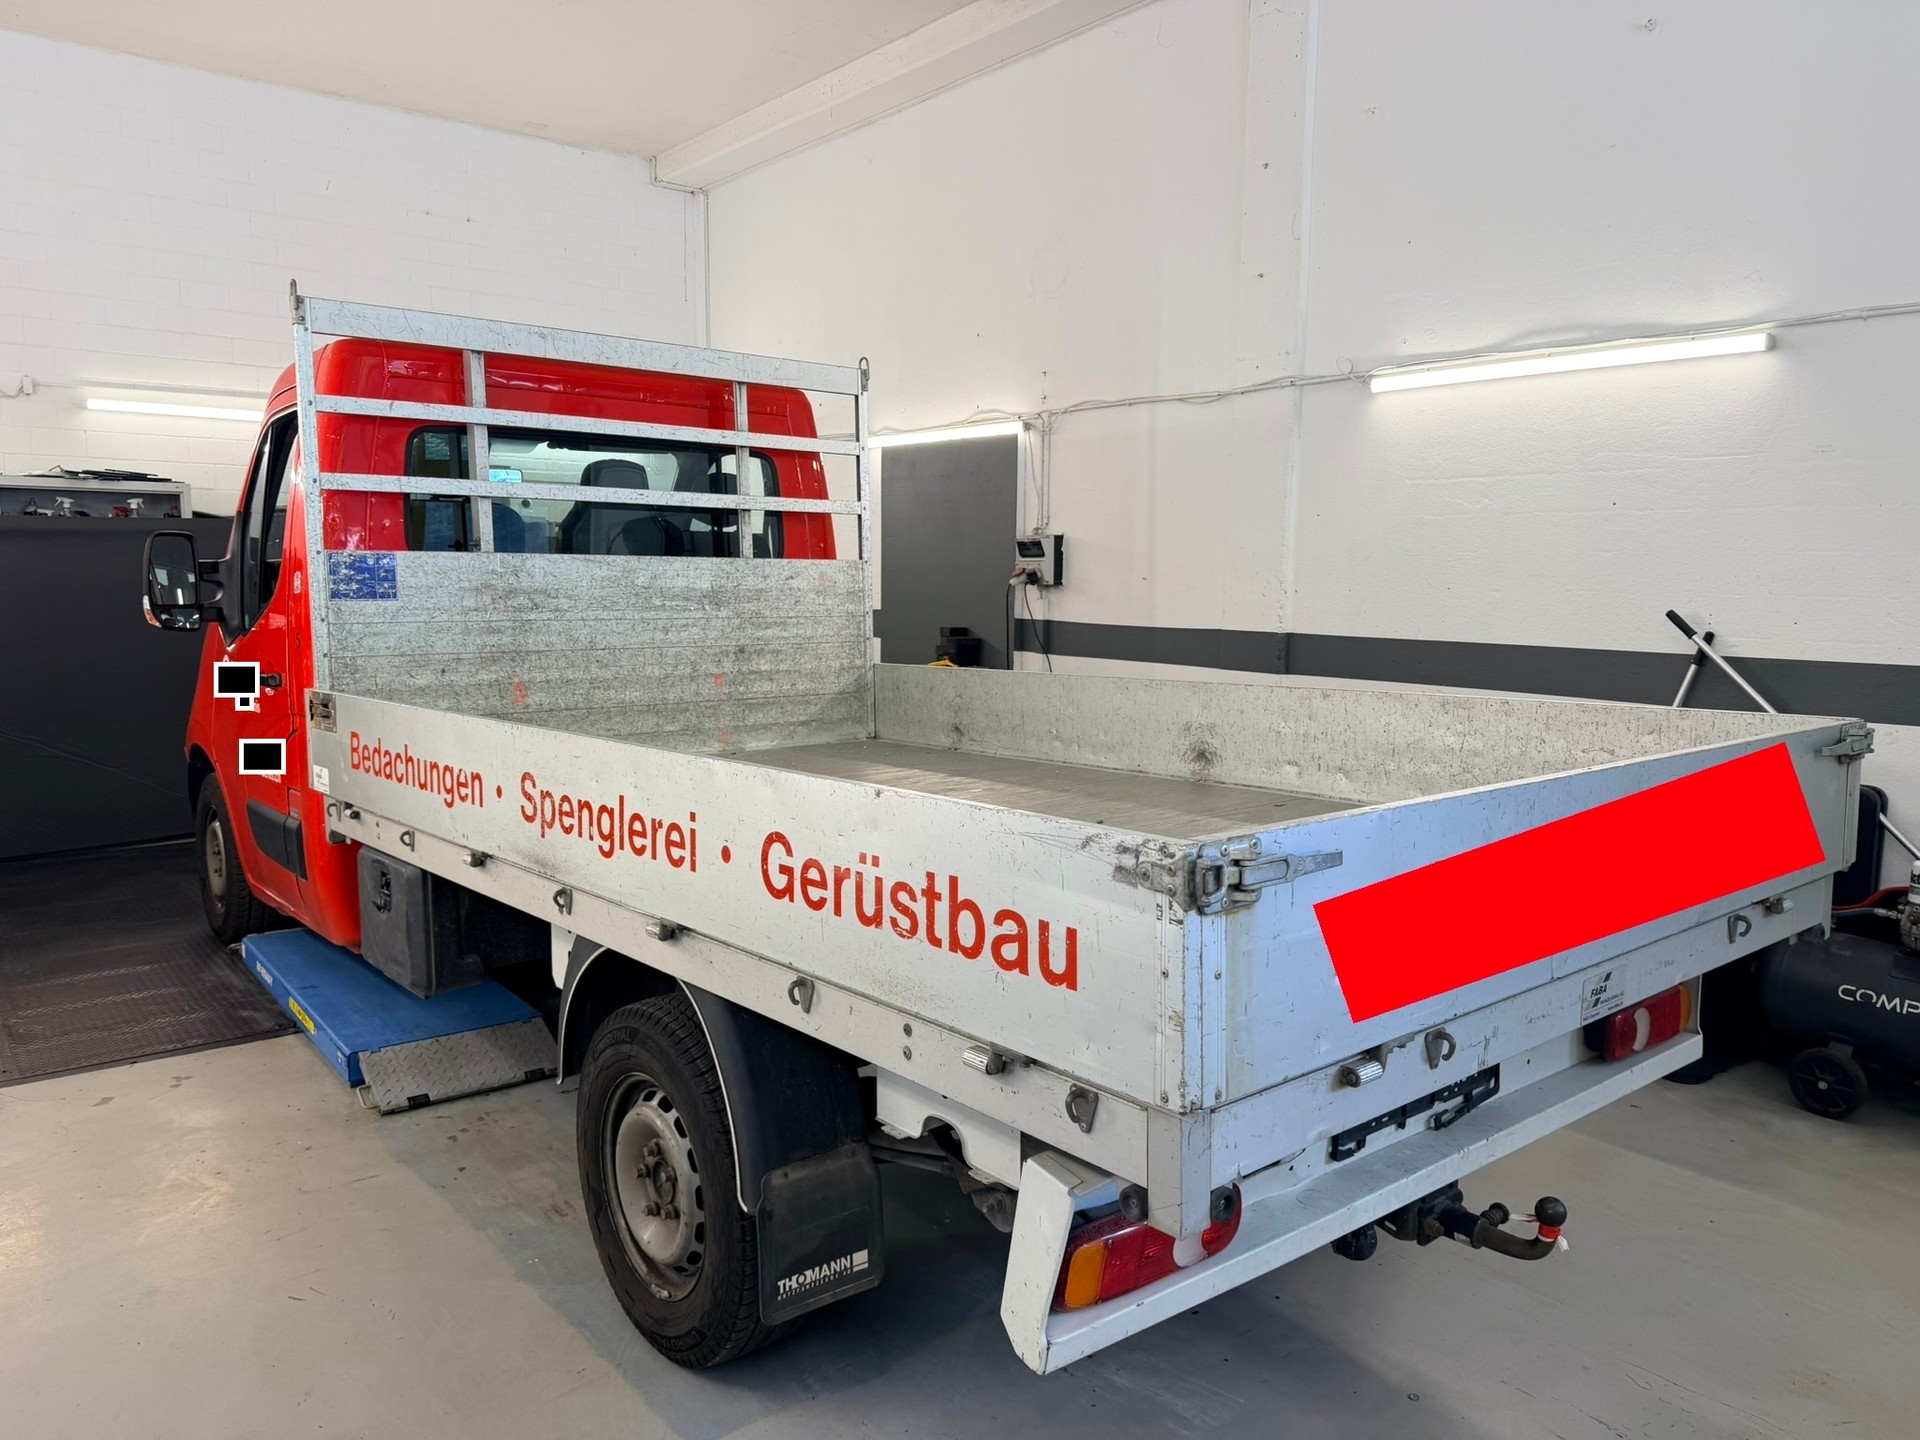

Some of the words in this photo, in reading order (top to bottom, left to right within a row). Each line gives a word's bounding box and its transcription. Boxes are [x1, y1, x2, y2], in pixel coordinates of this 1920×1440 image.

[350, 730, 485, 810] Bedachungen
[520, 772, 698, 873] Spenglerei
[760, 831, 1079, 993] Gerüstbau
[1590, 984, 1608, 998] FABA
[594, 1028, 631, 1058] UNIROYAL
[777, 1255, 851, 1295] THOMANN
